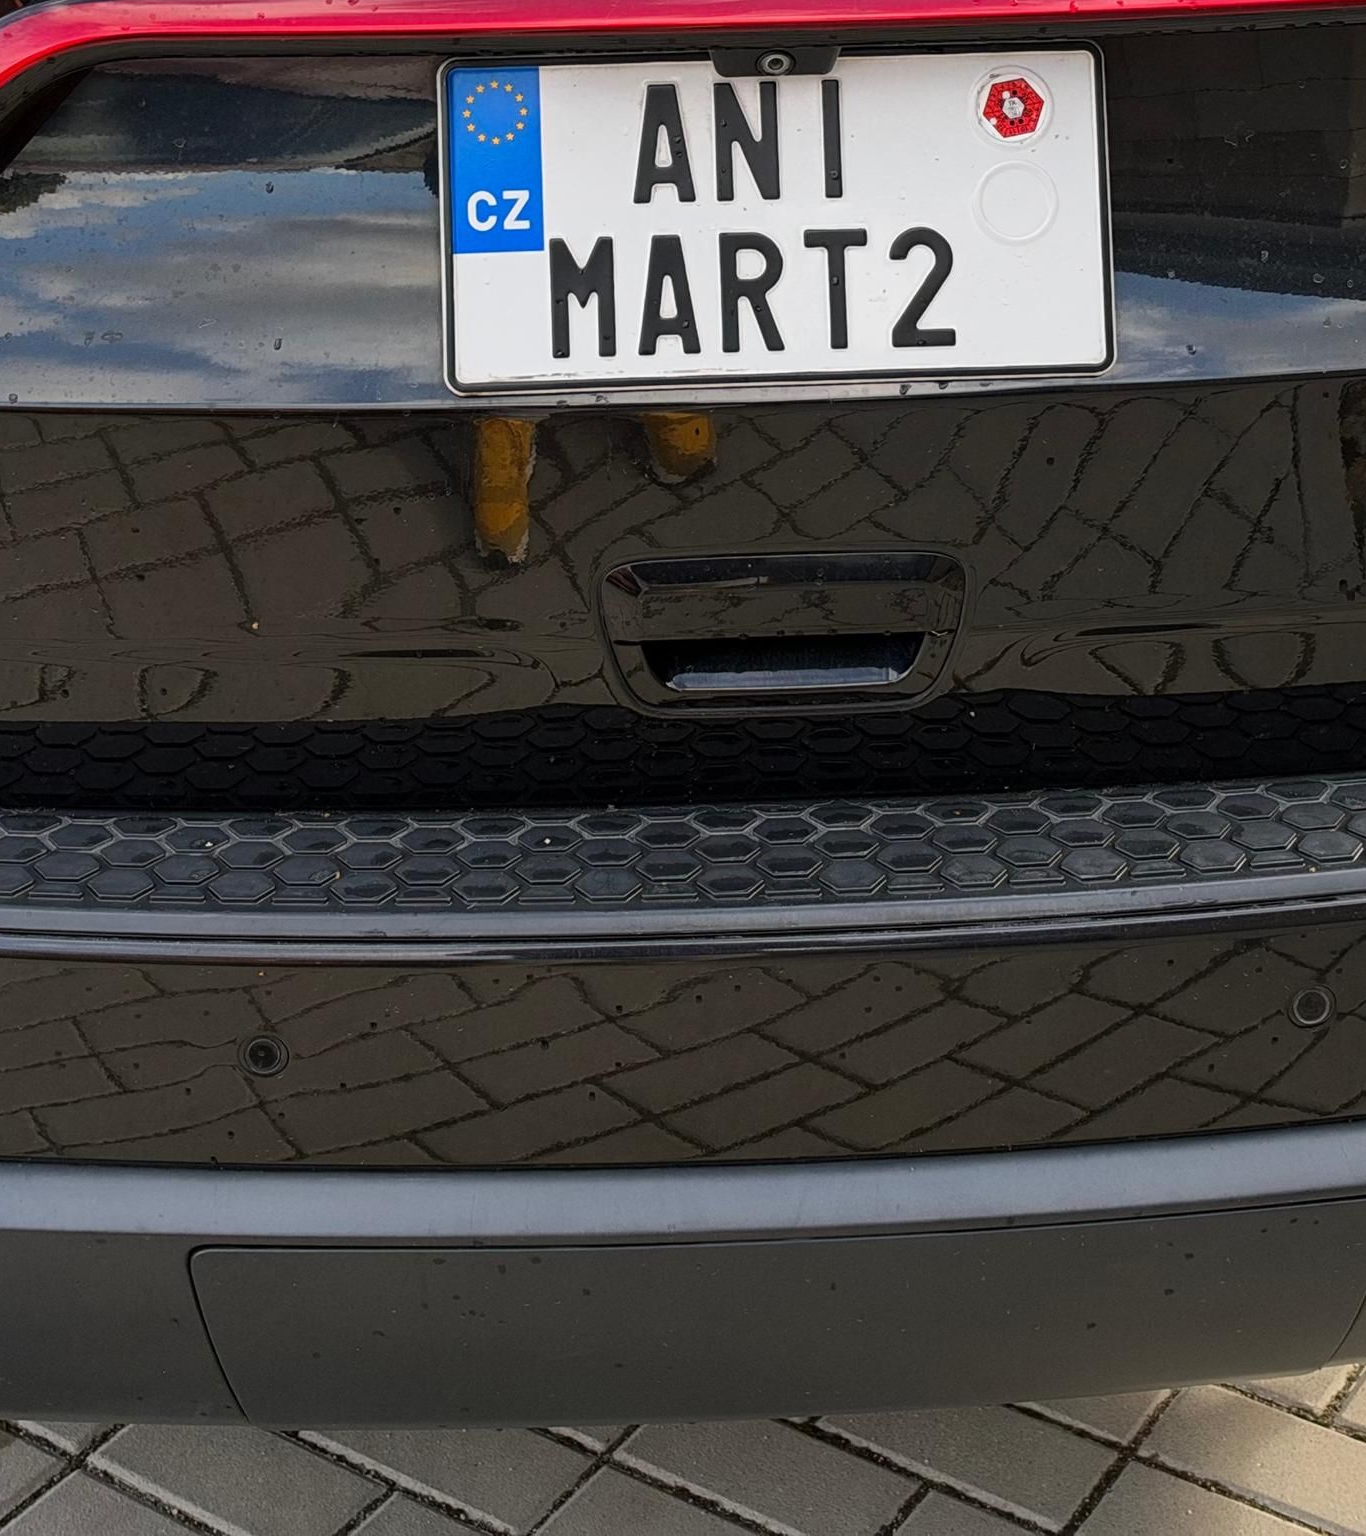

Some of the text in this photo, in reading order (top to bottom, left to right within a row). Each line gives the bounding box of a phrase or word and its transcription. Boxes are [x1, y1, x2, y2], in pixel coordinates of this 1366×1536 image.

[633, 78, 845, 204] ANI
[466, 189, 532, 232] CZ
[548, 226, 958, 359] MART2
